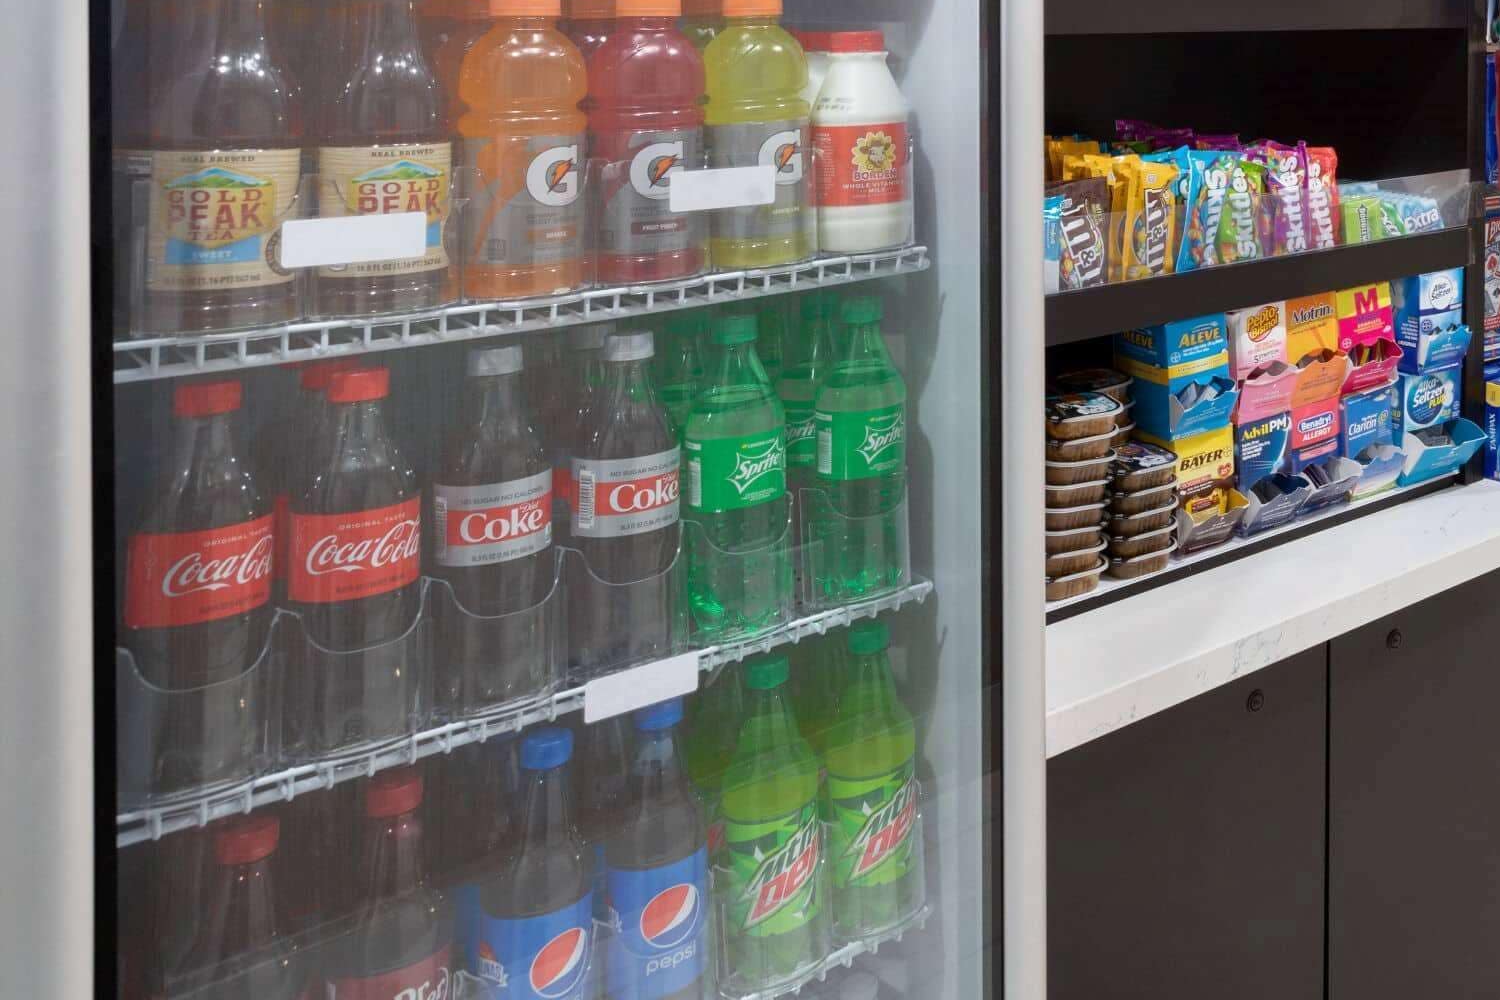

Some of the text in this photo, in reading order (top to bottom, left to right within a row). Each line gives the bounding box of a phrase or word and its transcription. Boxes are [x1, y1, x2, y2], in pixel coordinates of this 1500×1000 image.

[209, 154, 255, 163] BREWED
[371, 148, 435, 158] REAL BREWED
[758, 130, 801, 185] G
[526, 146, 578, 206] G
[630, 141, 684, 200] G
[853, 170, 897, 181] BORDEN
[168, 188, 264, 204] GOLD
[358, 180, 440, 195] GOLD
[167, 203, 264, 231] PEAK
[188, 228, 235, 241] TEA
[1179, 327, 1221, 348] ALEVE
[1241, 416, 1288, 441] Advil PM
[1300, 413, 1332, 432] Benadryl
[1488, 413, 1496, 451] TAMPAX
[1302, 427, 1332, 442] ALLERGY
[1180, 450, 1224, 472] BAYER
[609, 477, 679, 513] Coke
[338, 519, 380, 531] ORIGINAL
[460, 506, 543, 544] Coke
[203, 534, 246, 547] ORIGINAL
[306, 518, 421, 576] Coca-Cola
[162, 533, 273, 597] Coca-Col
[645, 943, 697, 977] pepsi
